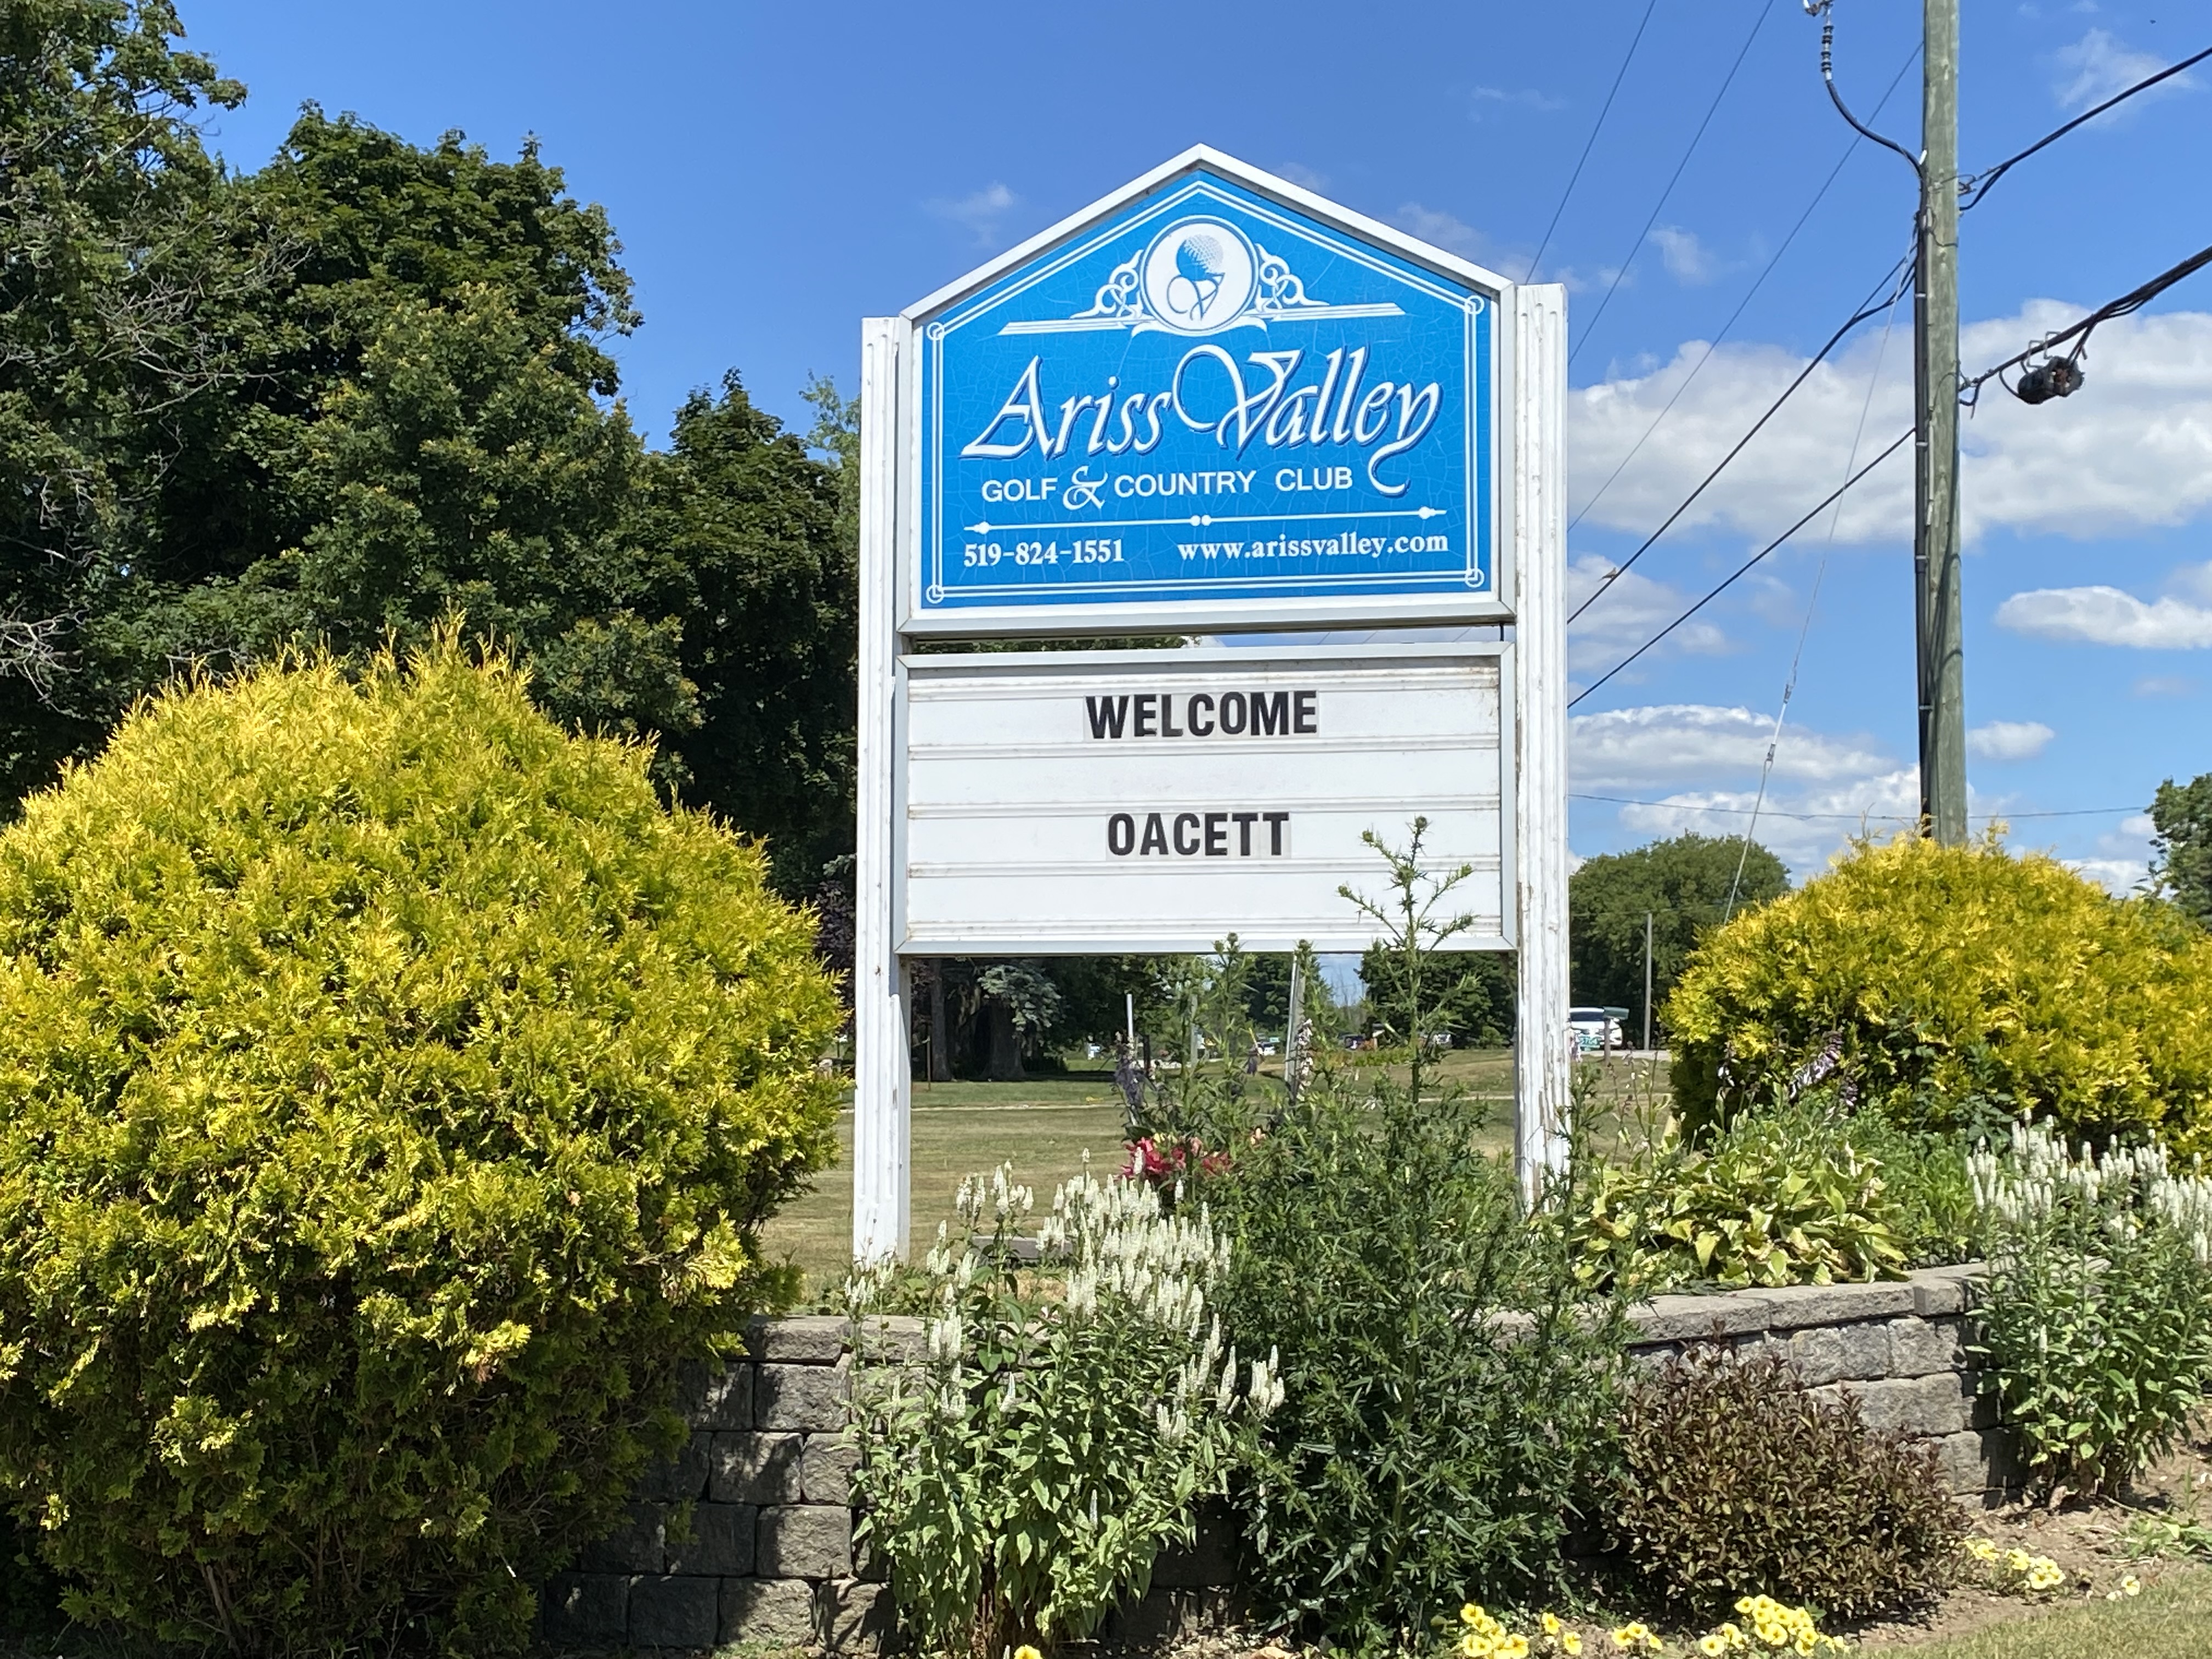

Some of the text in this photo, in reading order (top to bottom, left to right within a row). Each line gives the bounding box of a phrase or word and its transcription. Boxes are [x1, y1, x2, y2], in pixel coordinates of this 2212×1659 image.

[959, 344, 1444, 497] Ariss Valley
[981, 465, 1353, 511] GOLF & COUNTRY CLUB
[963, 539, 1124, 567] 519-824-1551
[1178, 531, 1448, 561] www.arissvalley.com
[1085, 690, 1317, 740] WELCOME
[1108, 811, 1290, 856] OACETT
